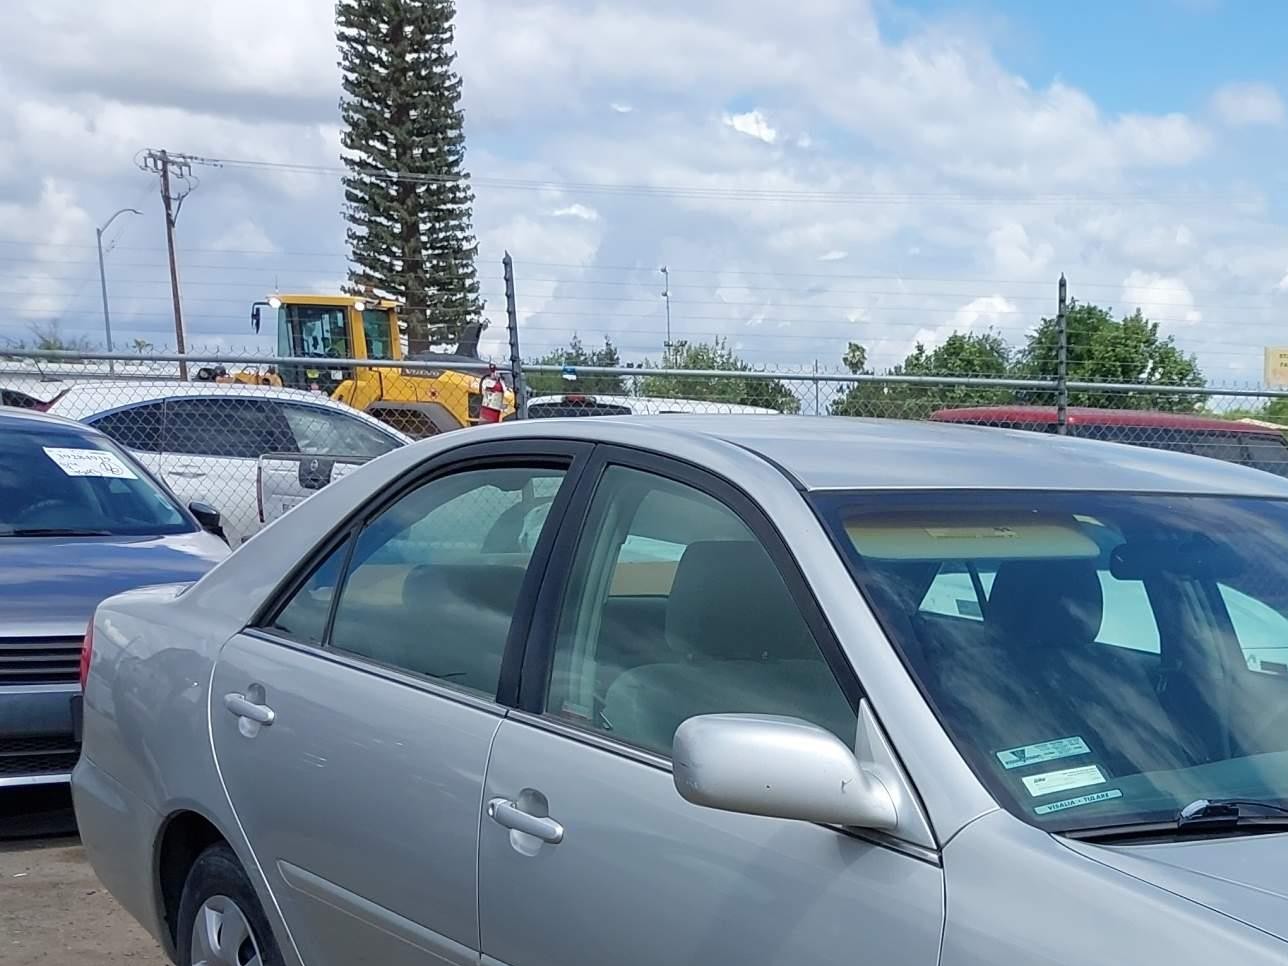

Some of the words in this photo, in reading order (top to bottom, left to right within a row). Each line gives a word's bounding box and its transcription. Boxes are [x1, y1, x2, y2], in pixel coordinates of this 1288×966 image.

[405, 368, 440, 378] VOLVO
[1047, 799, 1076, 811] VISALIA
[1083, 792, 1110, 802] TULARE
